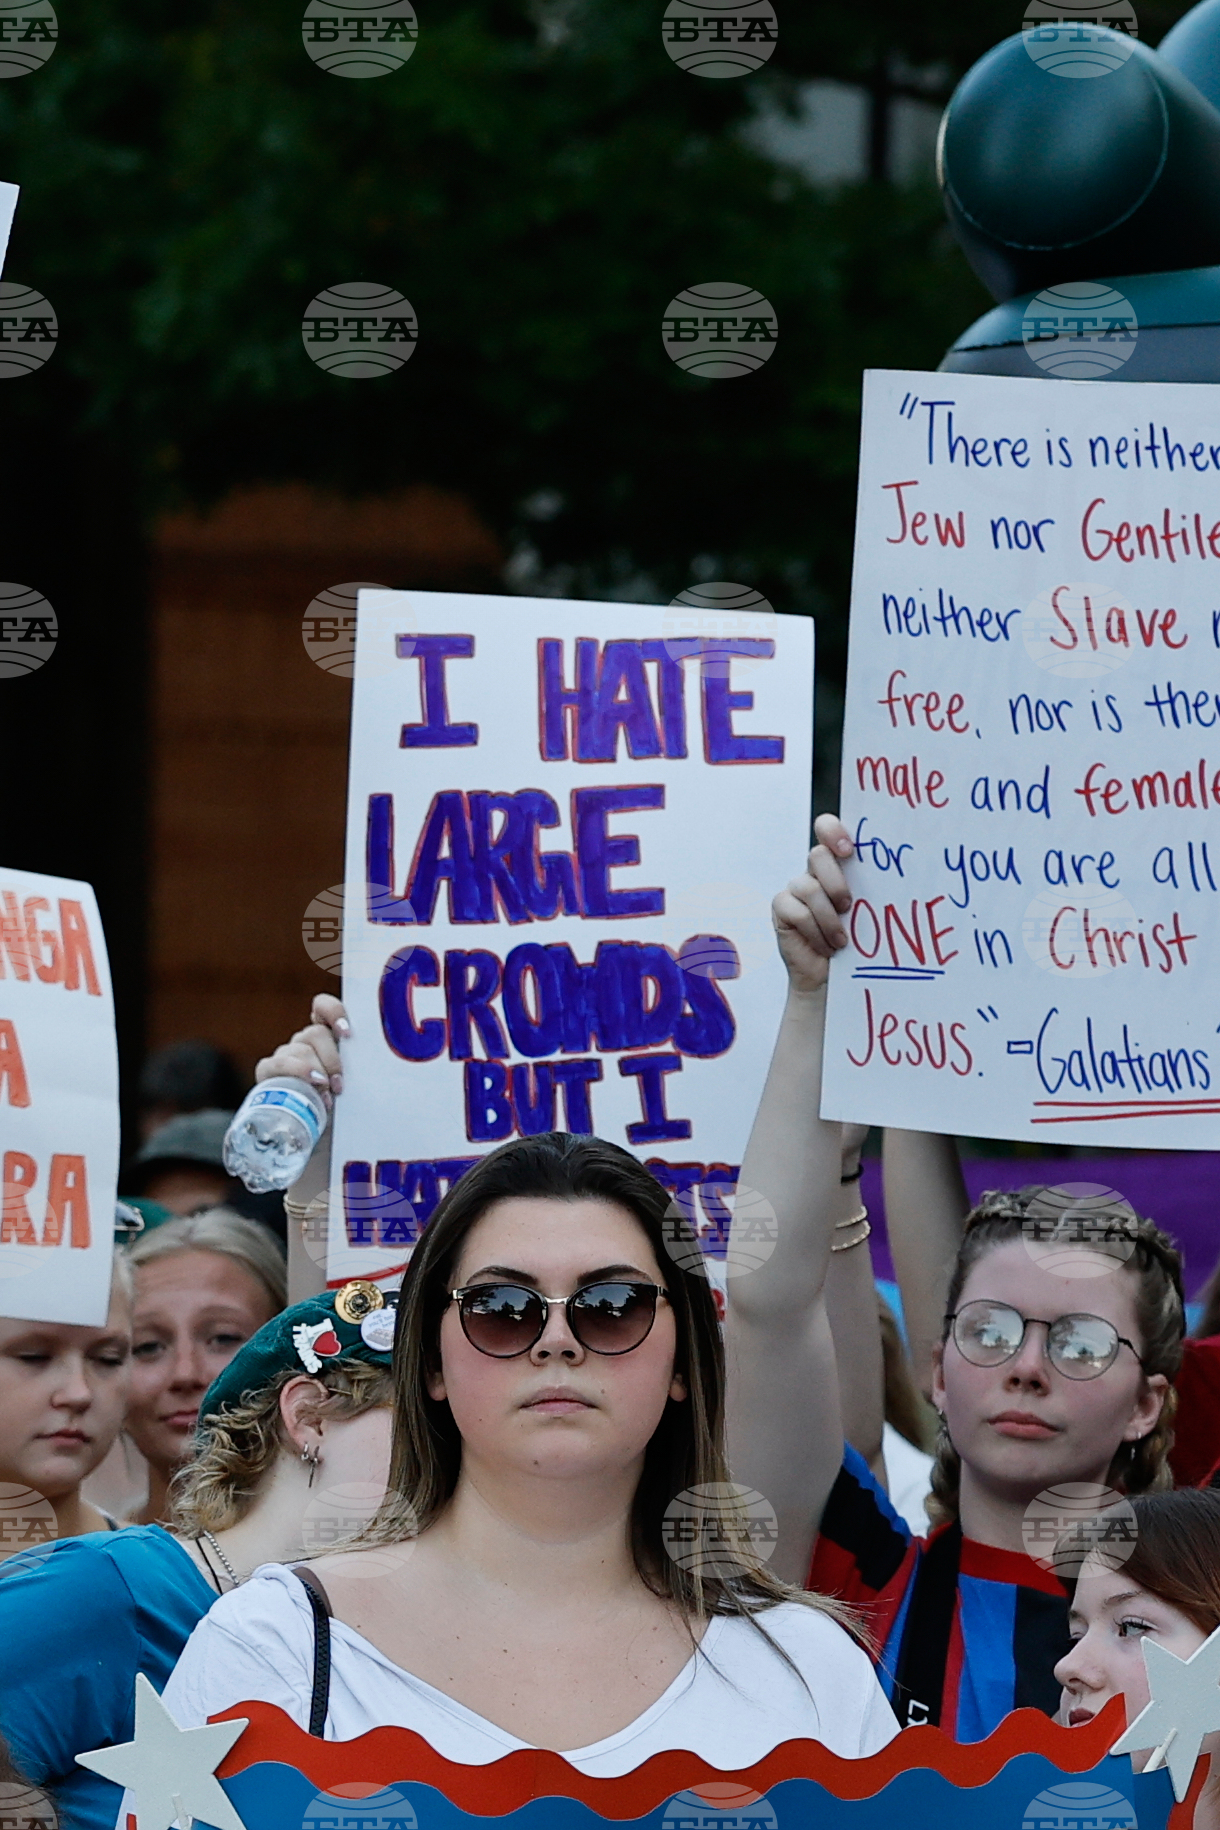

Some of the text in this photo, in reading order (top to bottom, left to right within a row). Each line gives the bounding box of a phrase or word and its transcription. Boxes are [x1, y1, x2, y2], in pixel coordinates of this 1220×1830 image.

[1046, 428, 1073, 469] is
[881, 480, 966, 549] Jew
[990, 516, 1056, 554] nor
[882, 587, 1022, 643] neither
[1049, 585, 1189, 652] Slave
[396, 633, 786, 765] I HATE
[1008, 692, 1074, 735] nor
[1090, 689, 1124, 734] is
[856, 755, 950, 809] male
[970, 764, 1051, 820] and
[366, 784, 666, 926] LARGE
[852, 816, 1218, 909] for you are all
[849, 895, 1198, 975] ONE in Christ
[379, 934, 742, 1062] CROWDS
[464, 1052, 693, 1145] BUT I
